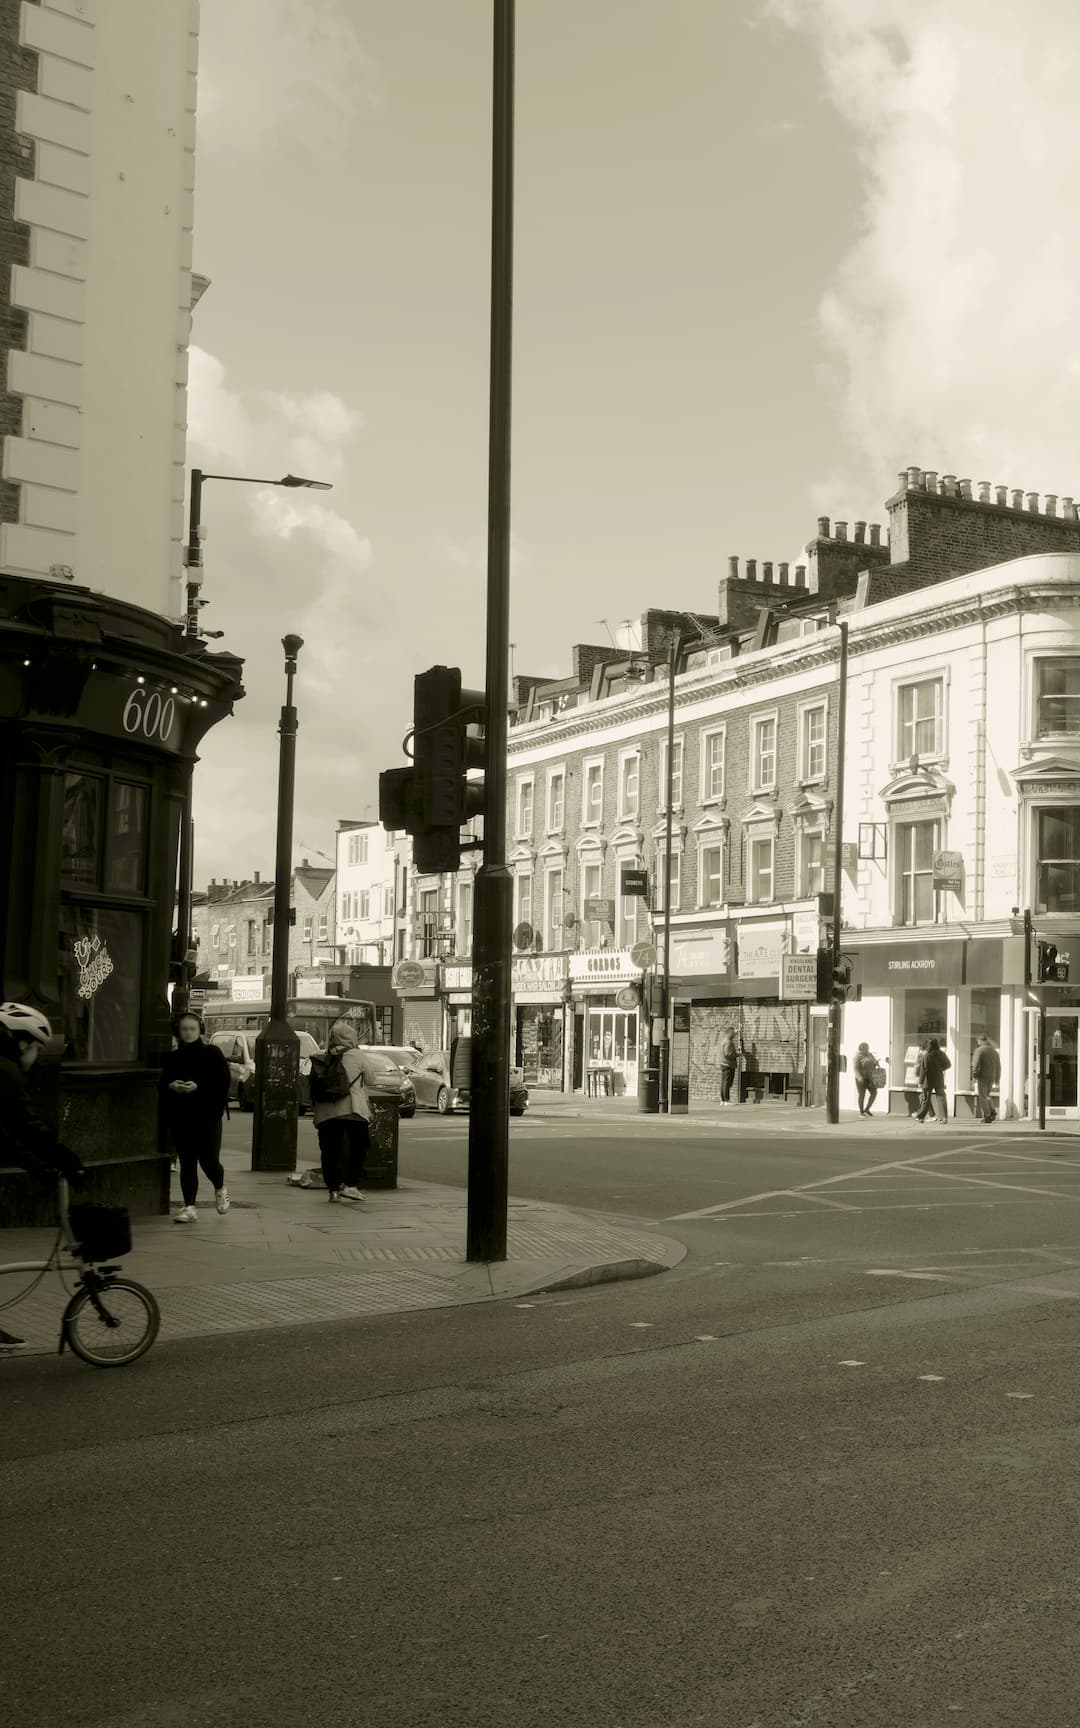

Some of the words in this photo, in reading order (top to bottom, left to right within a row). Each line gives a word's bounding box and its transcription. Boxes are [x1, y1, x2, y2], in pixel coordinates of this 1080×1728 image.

[123, 688, 175, 741] 600
[587, 957, 621, 972] GORDOS
[788, 965, 814, 973] DENTAL
[888, 961, 911, 969] STIRLING
[911, 960, 935, 969] ACKROYD
